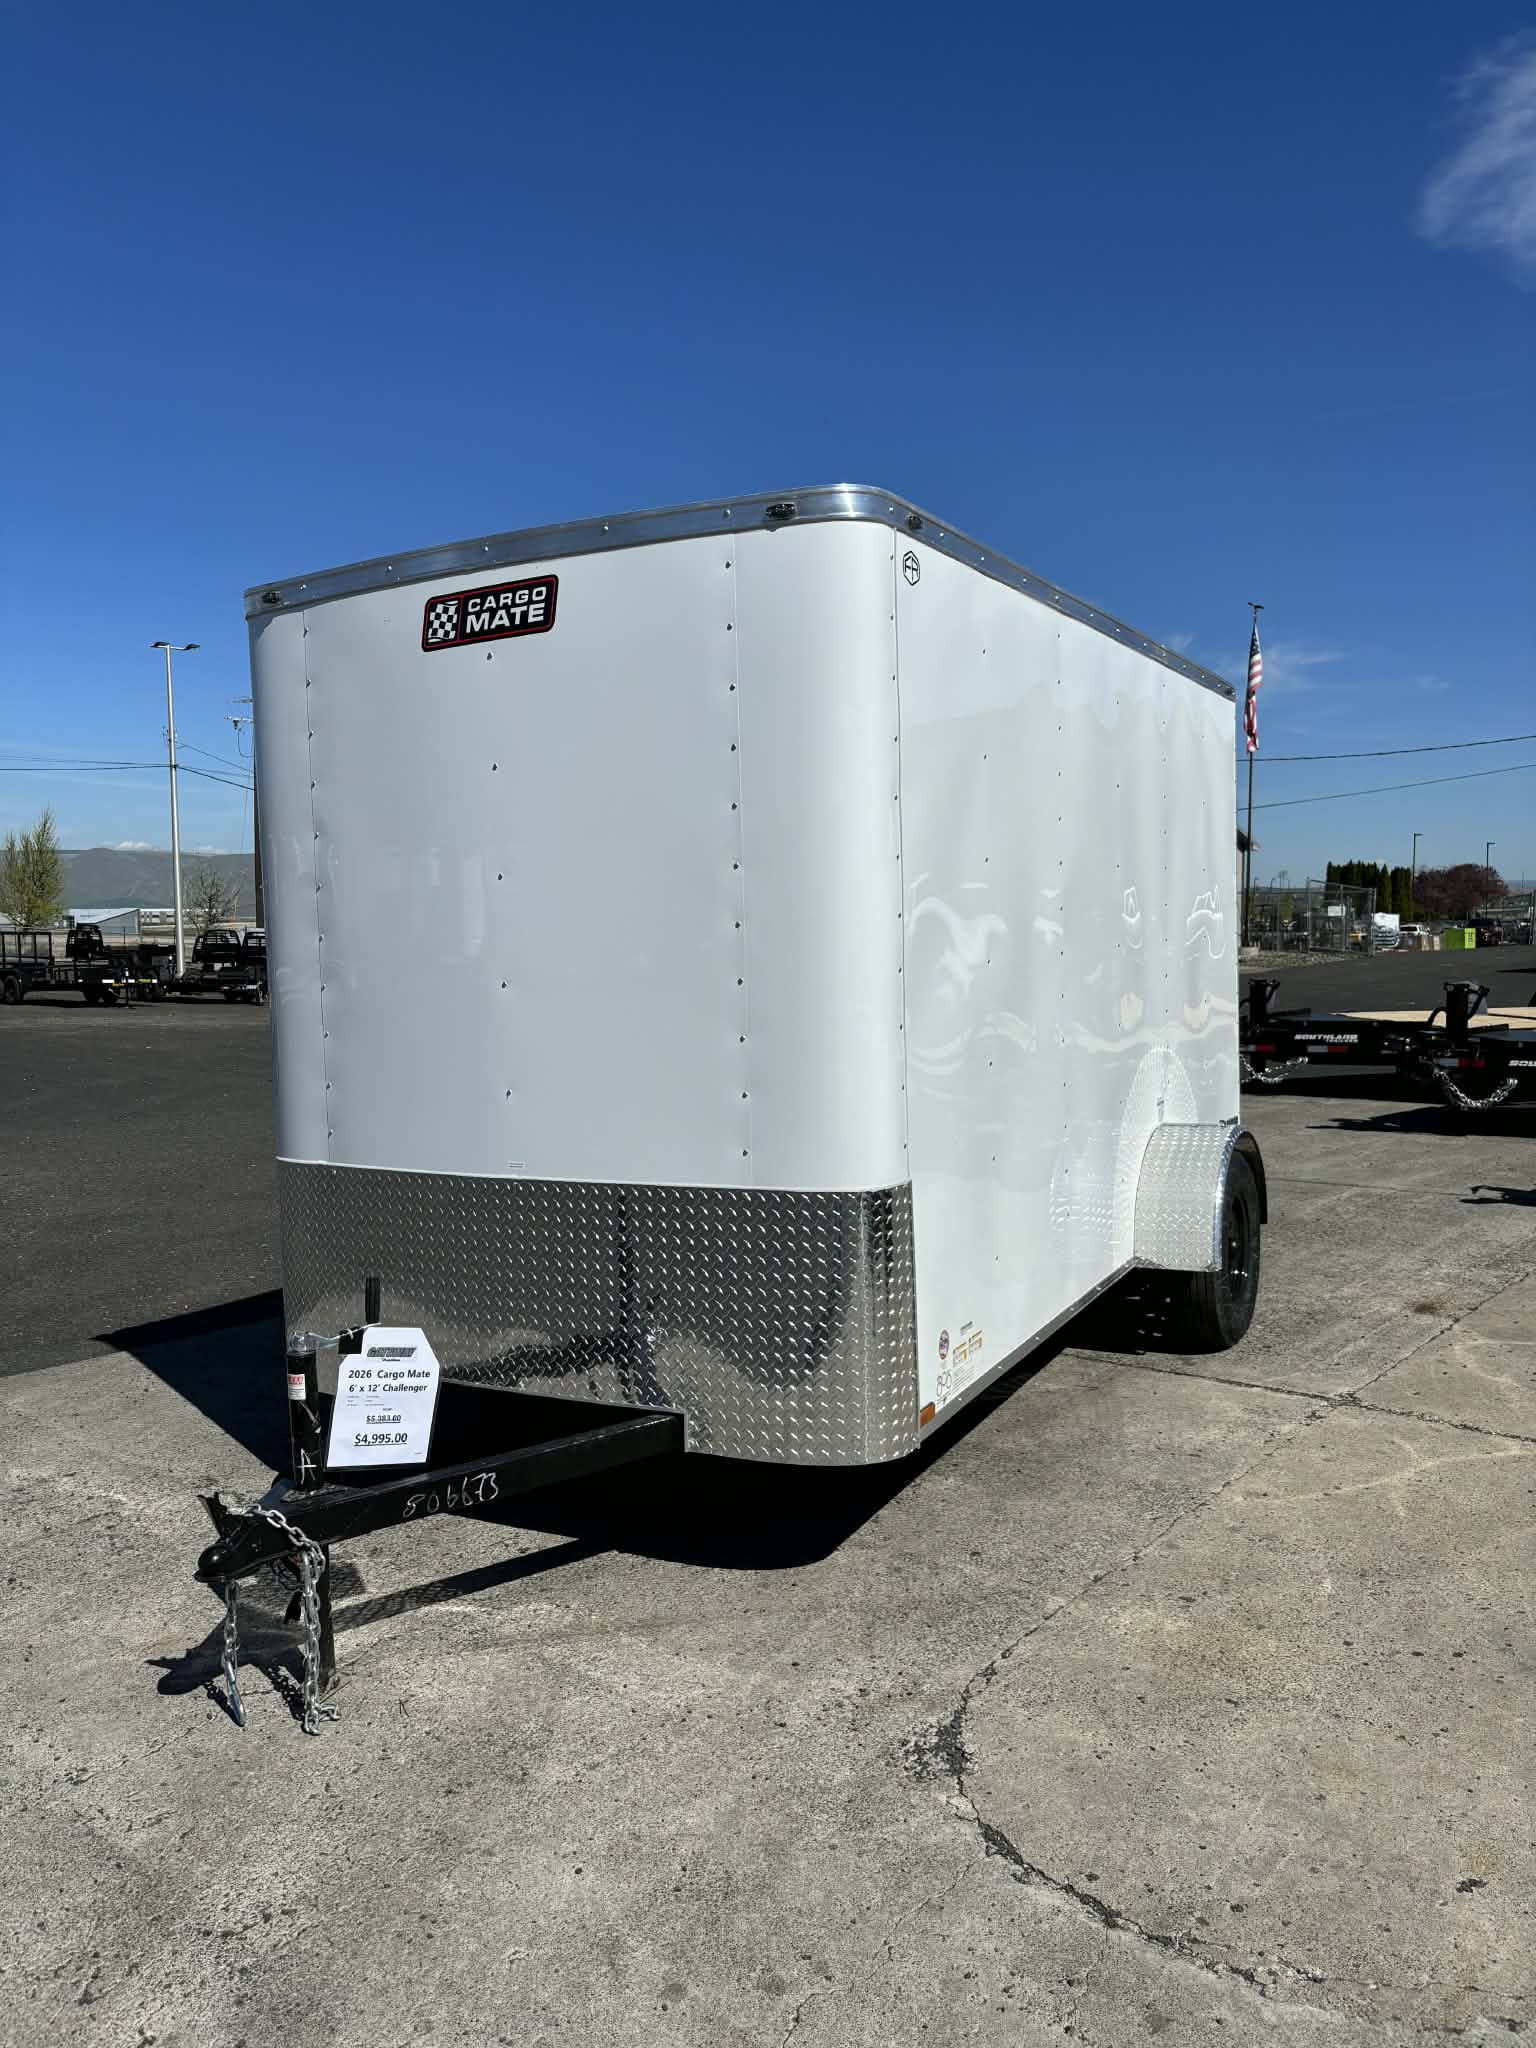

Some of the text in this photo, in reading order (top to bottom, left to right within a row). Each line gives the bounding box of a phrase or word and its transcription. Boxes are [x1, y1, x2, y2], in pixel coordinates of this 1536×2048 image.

[467, 586, 547, 613] CARGO
[465, 602, 546, 634] MATE
[348, 1369, 431, 1381] 2026 Cargo Mate
[382, 1383, 428, 1394] Challenger
[353, 1432, 408, 1446] $4,995.00
